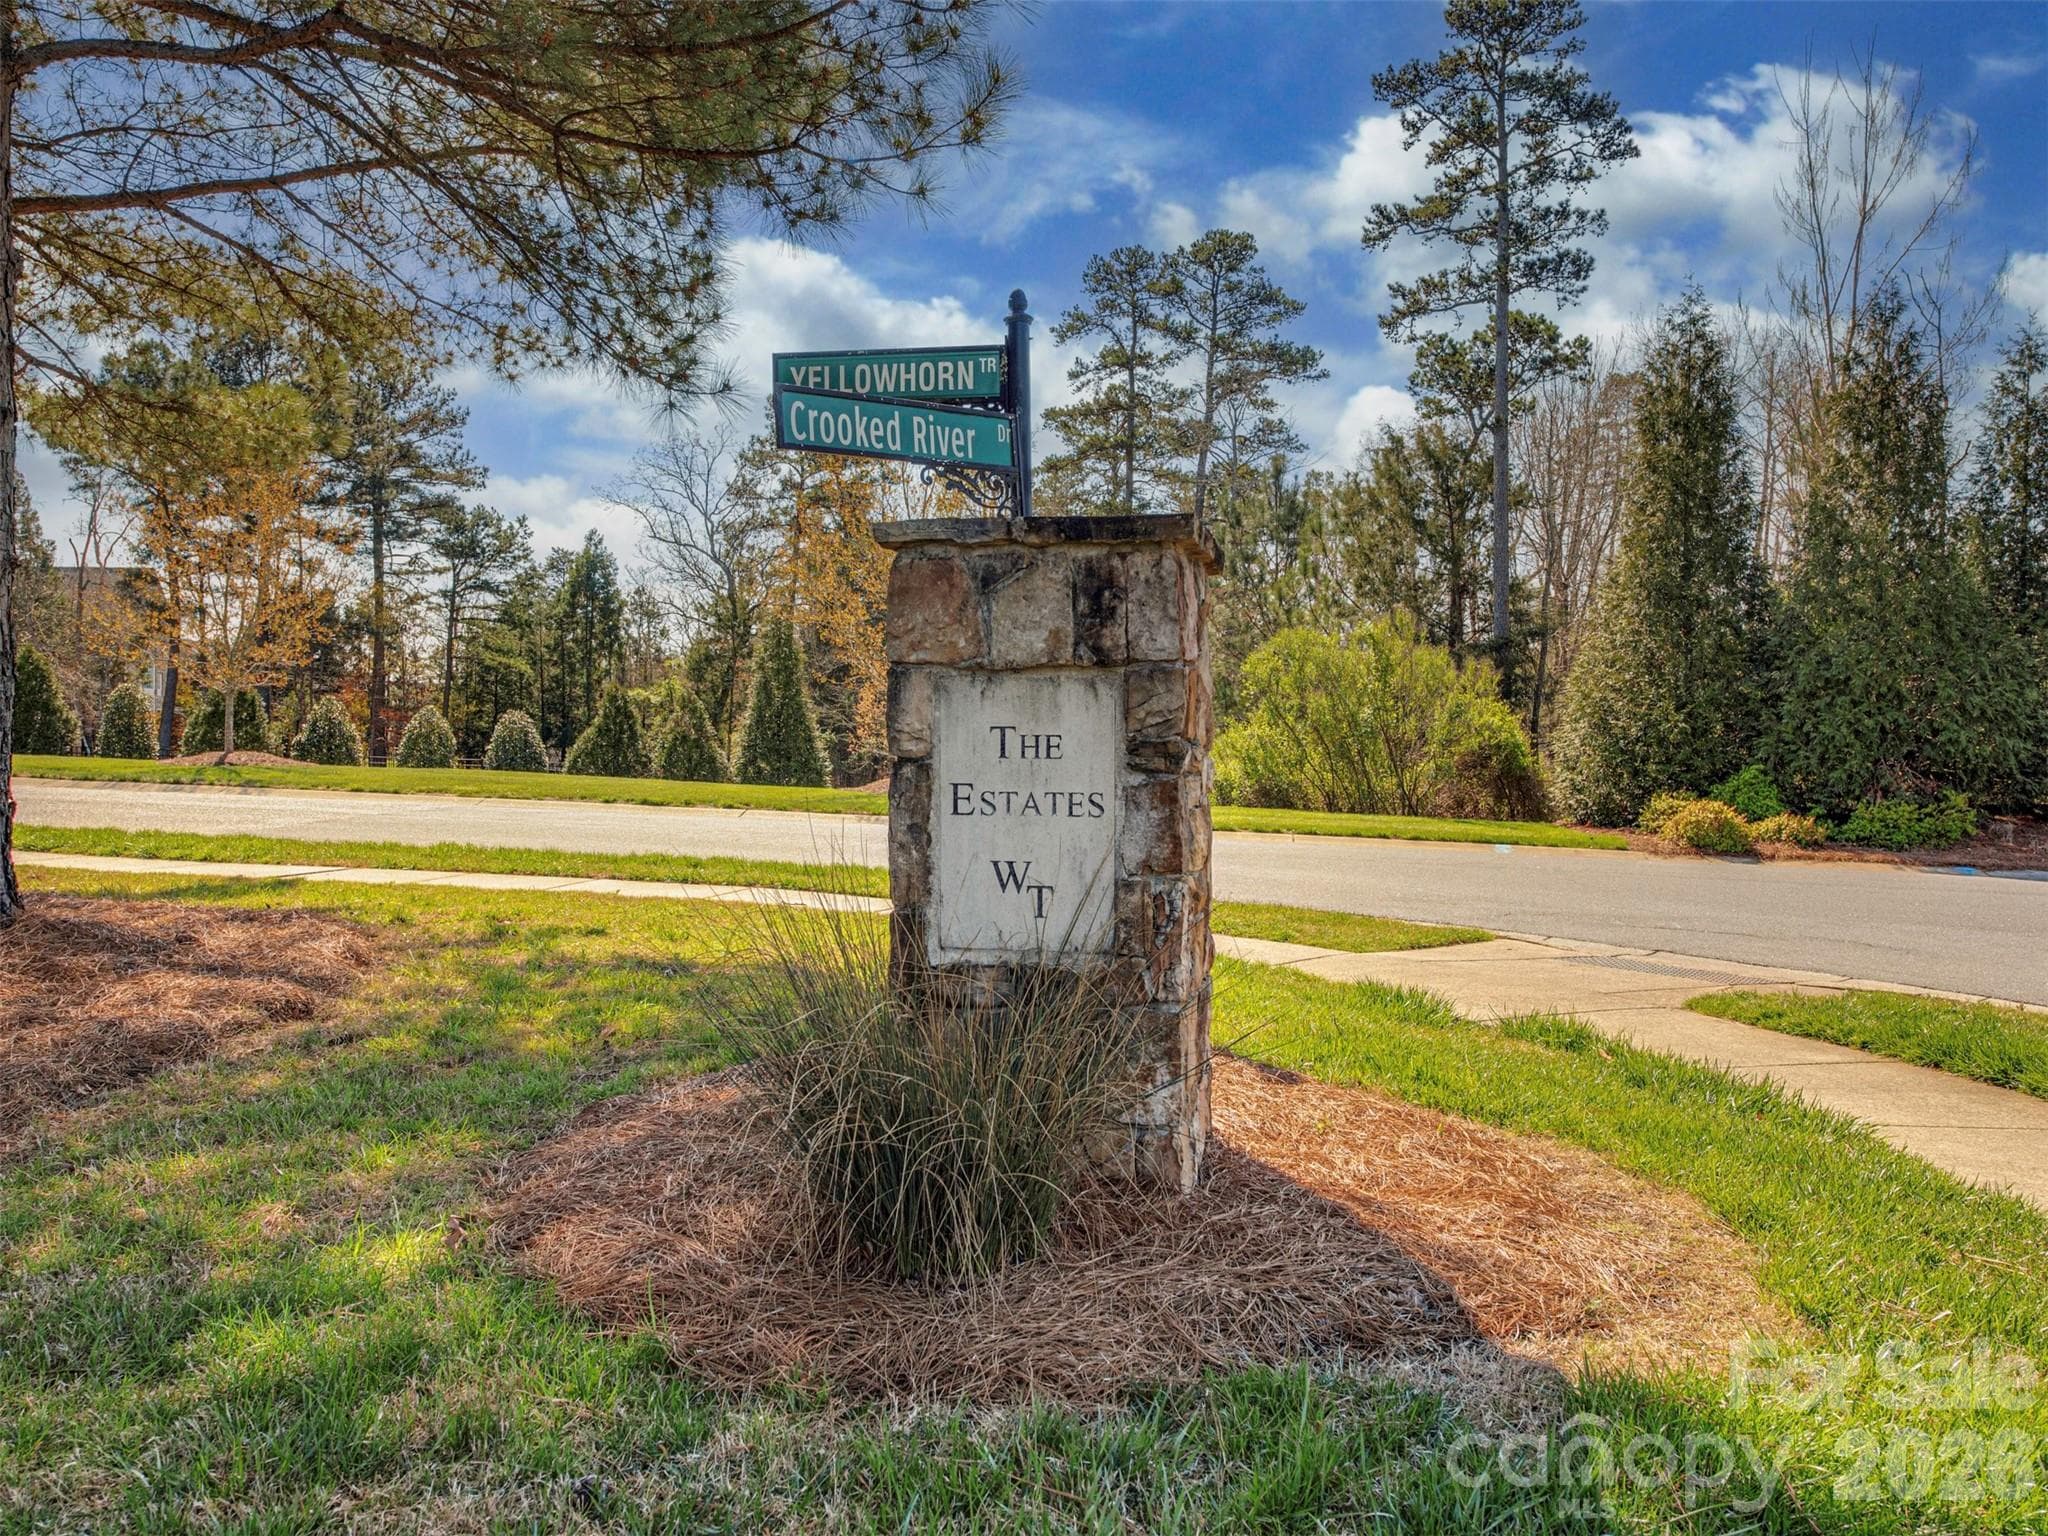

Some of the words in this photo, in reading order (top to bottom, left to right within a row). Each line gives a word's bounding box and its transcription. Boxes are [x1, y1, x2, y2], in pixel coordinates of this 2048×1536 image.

[790, 360, 974, 393] YELLOWHORN
[979, 357, 997, 373] TR
[790, 400, 901, 451] Crooked
[912, 415, 976, 459] River
